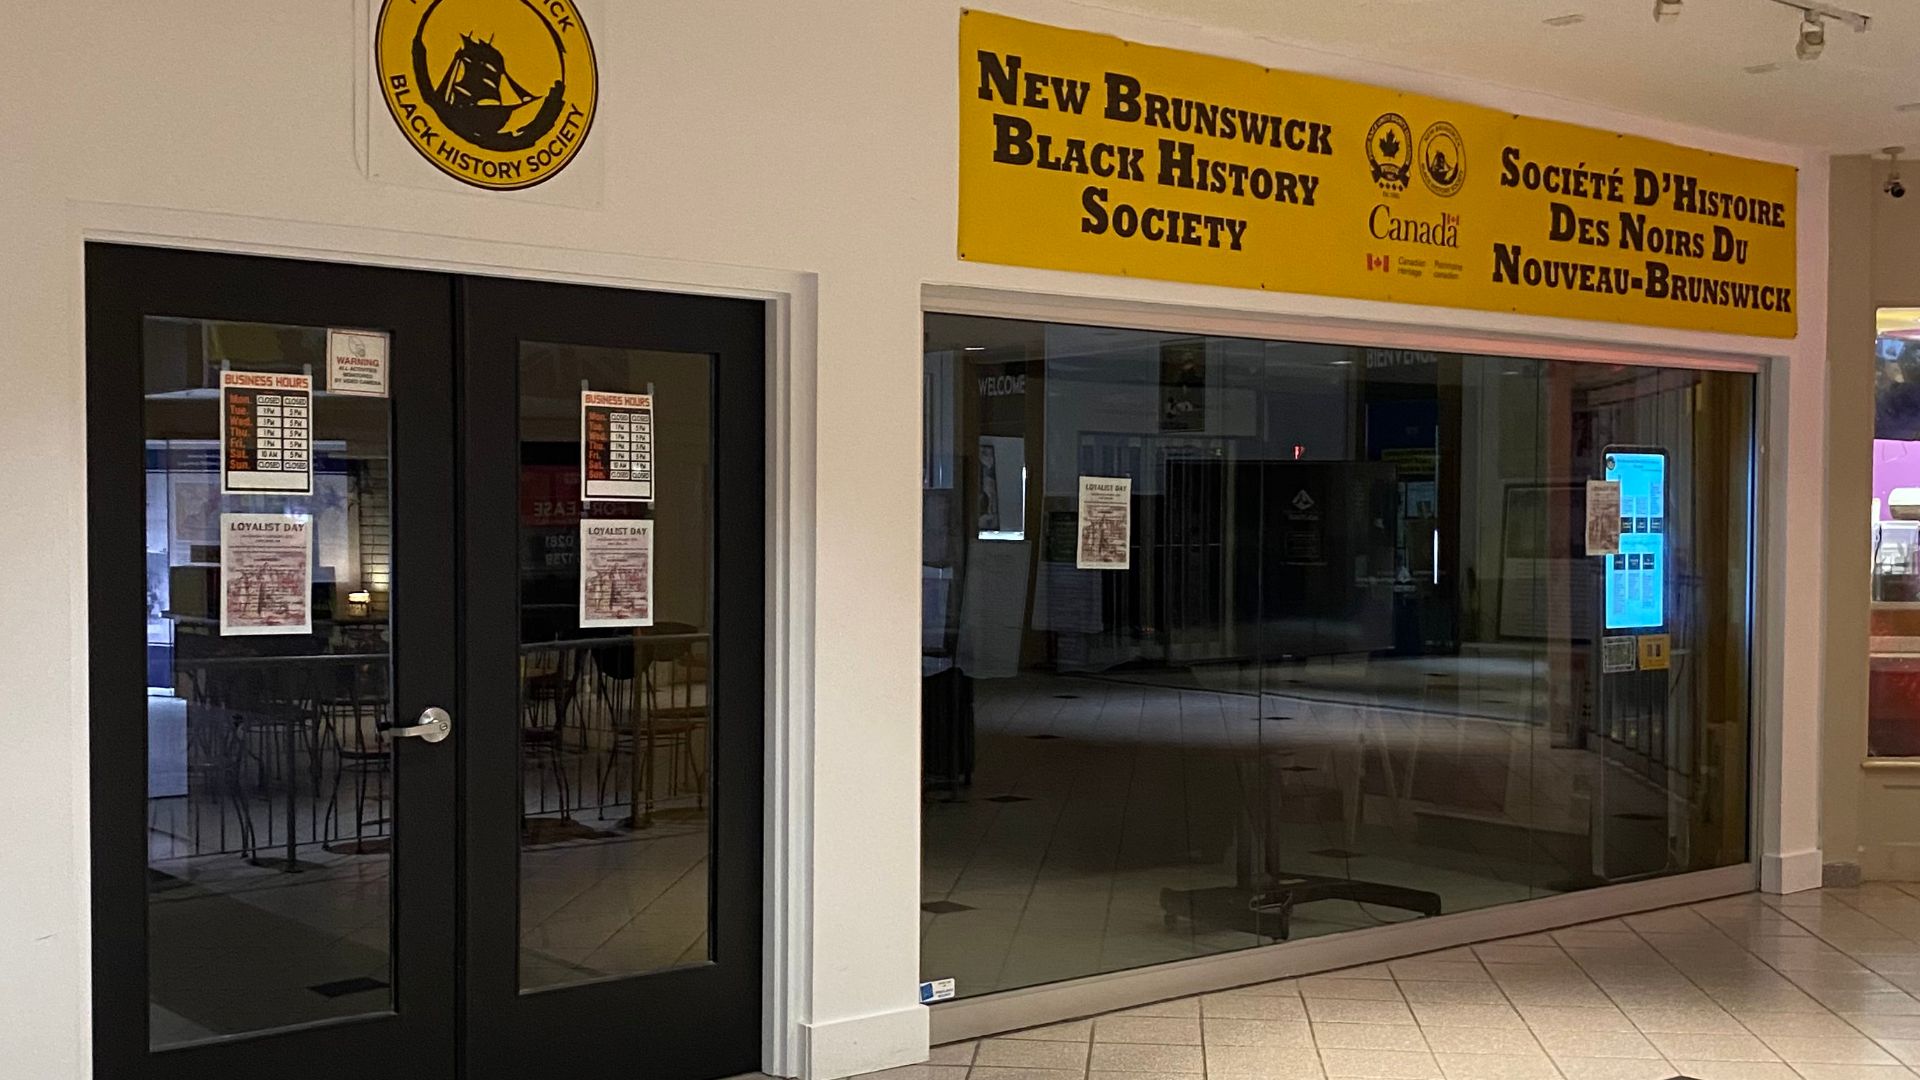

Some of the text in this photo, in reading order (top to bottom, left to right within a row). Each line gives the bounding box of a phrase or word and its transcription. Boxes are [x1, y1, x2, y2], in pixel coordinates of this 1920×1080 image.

[978, 49, 1090, 115] NEW
[1104, 72, 1332, 155] BRUNSWICK
[390, 74, 585, 179] BLACK HISTORY SOCIETY
[993, 113, 1144, 181] BLACK
[1157, 138, 1319, 206] HISTORY
[1501, 146, 1623, 203] SOCIÉTÉ
[1081, 186, 1247, 251] SOCIETY
[1369, 204, 1459, 248] Canada
[1549, 202, 1748, 264] DES NOIRS DU
[1492, 243, 1791, 313] NOUVEAU-BRUNSWICK
[336, 356, 379, 367] WARNING
[225, 374, 309, 389] BUSINESS HOURS
[978, 374, 1025, 397] WELCOME
[258, 396, 280, 404] CLOSED
[284, 397, 307, 406] CLOSED
[585, 394, 650, 407] BUSINESS HOURS
[258, 461, 280, 469] CLOSED
[284, 461, 307, 470] CLOSED
[230, 522, 305, 532] LOYALIST DAY
[588, 527, 648, 536] LOYALIST DAY
